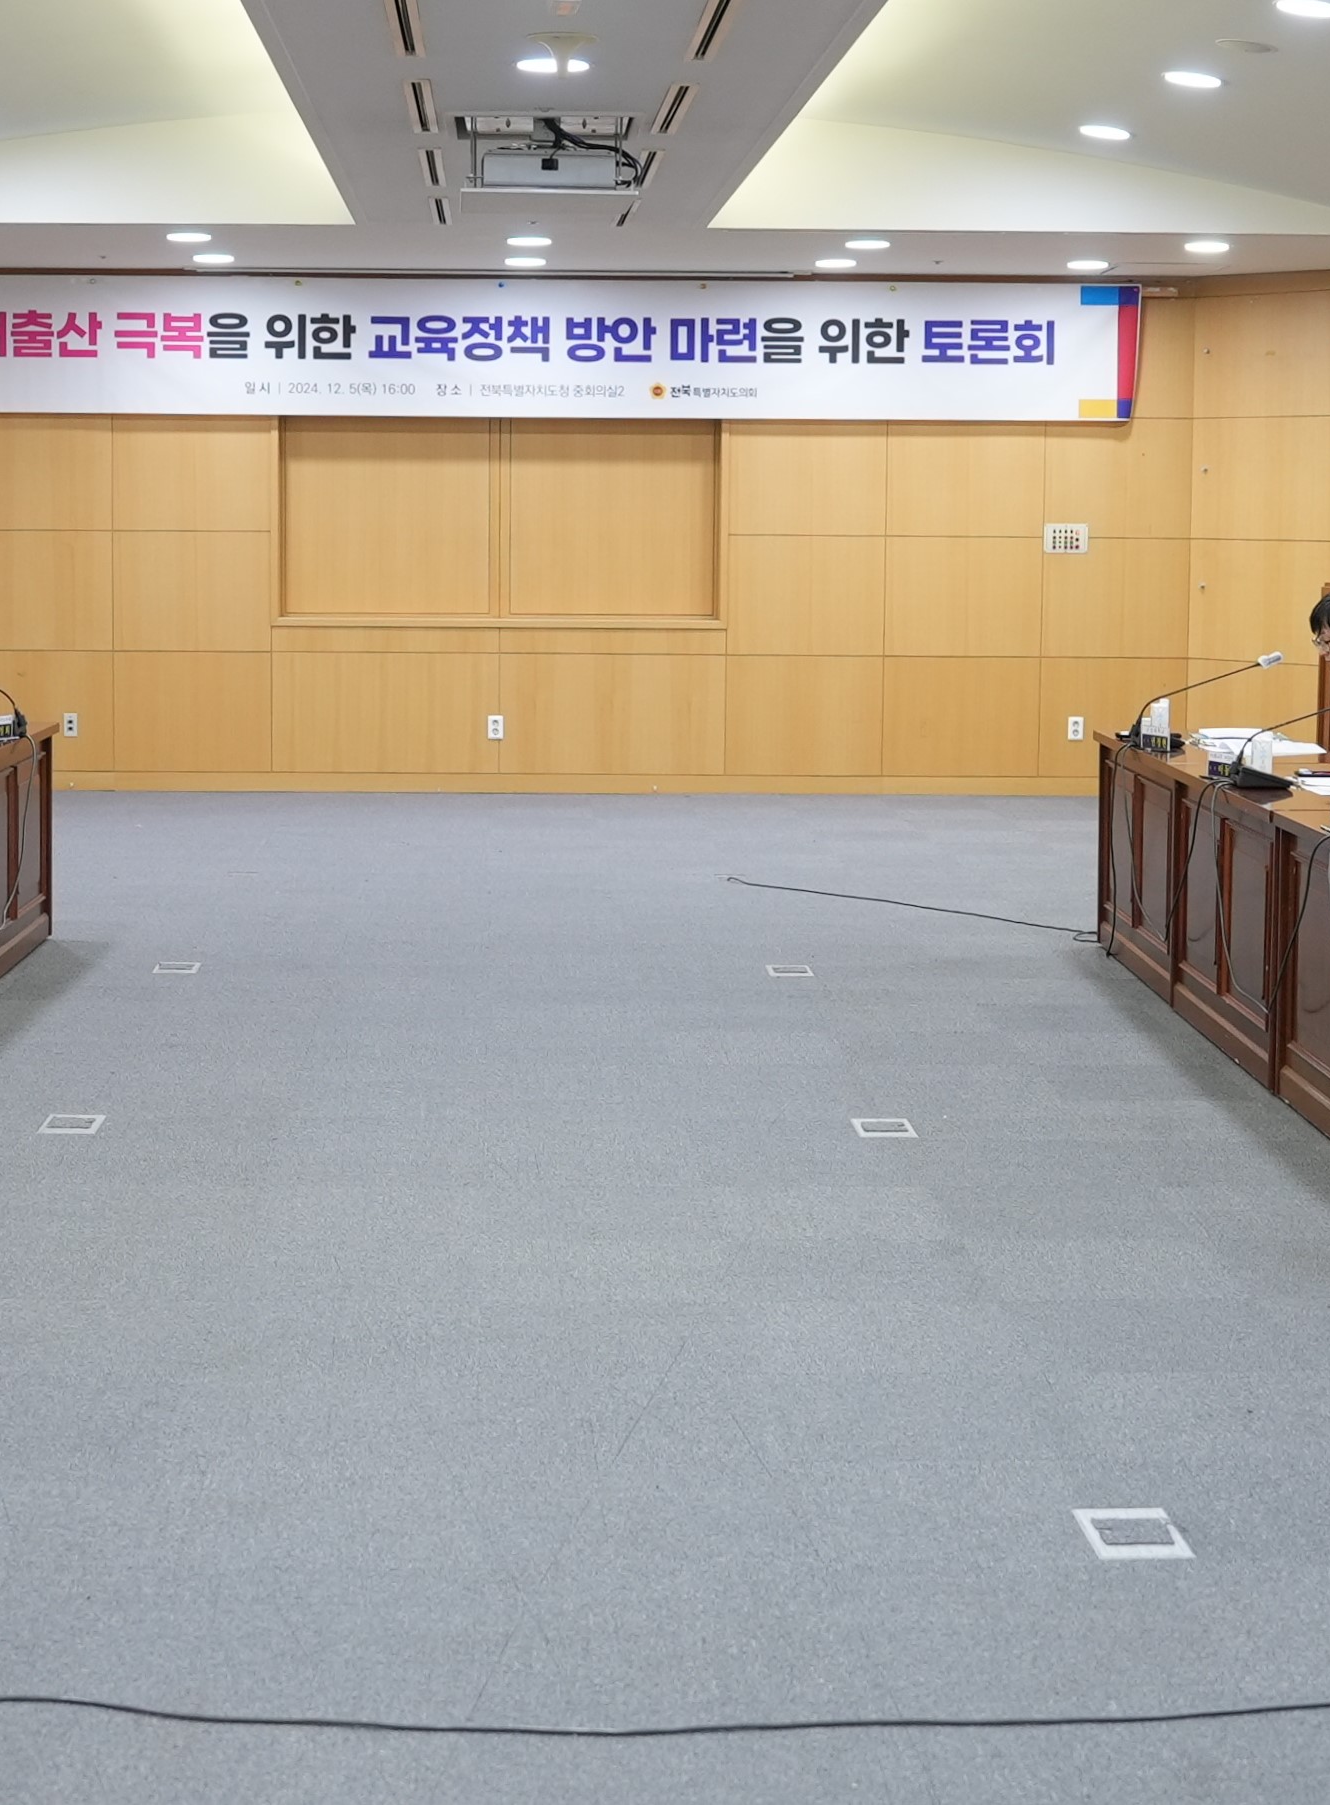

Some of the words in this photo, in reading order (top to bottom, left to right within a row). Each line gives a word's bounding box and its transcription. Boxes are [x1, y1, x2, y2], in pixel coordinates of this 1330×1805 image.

[114, 312, 250, 360] 극복을
[265, 313, 356, 361] 위한
[368, 315, 550, 363] 교육정책
[565, 317, 657, 363] 방안
[670, 317, 804, 364] 마련을
[818, 318, 910, 365] 위한
[921, 319, 1056, 366] 토론회
